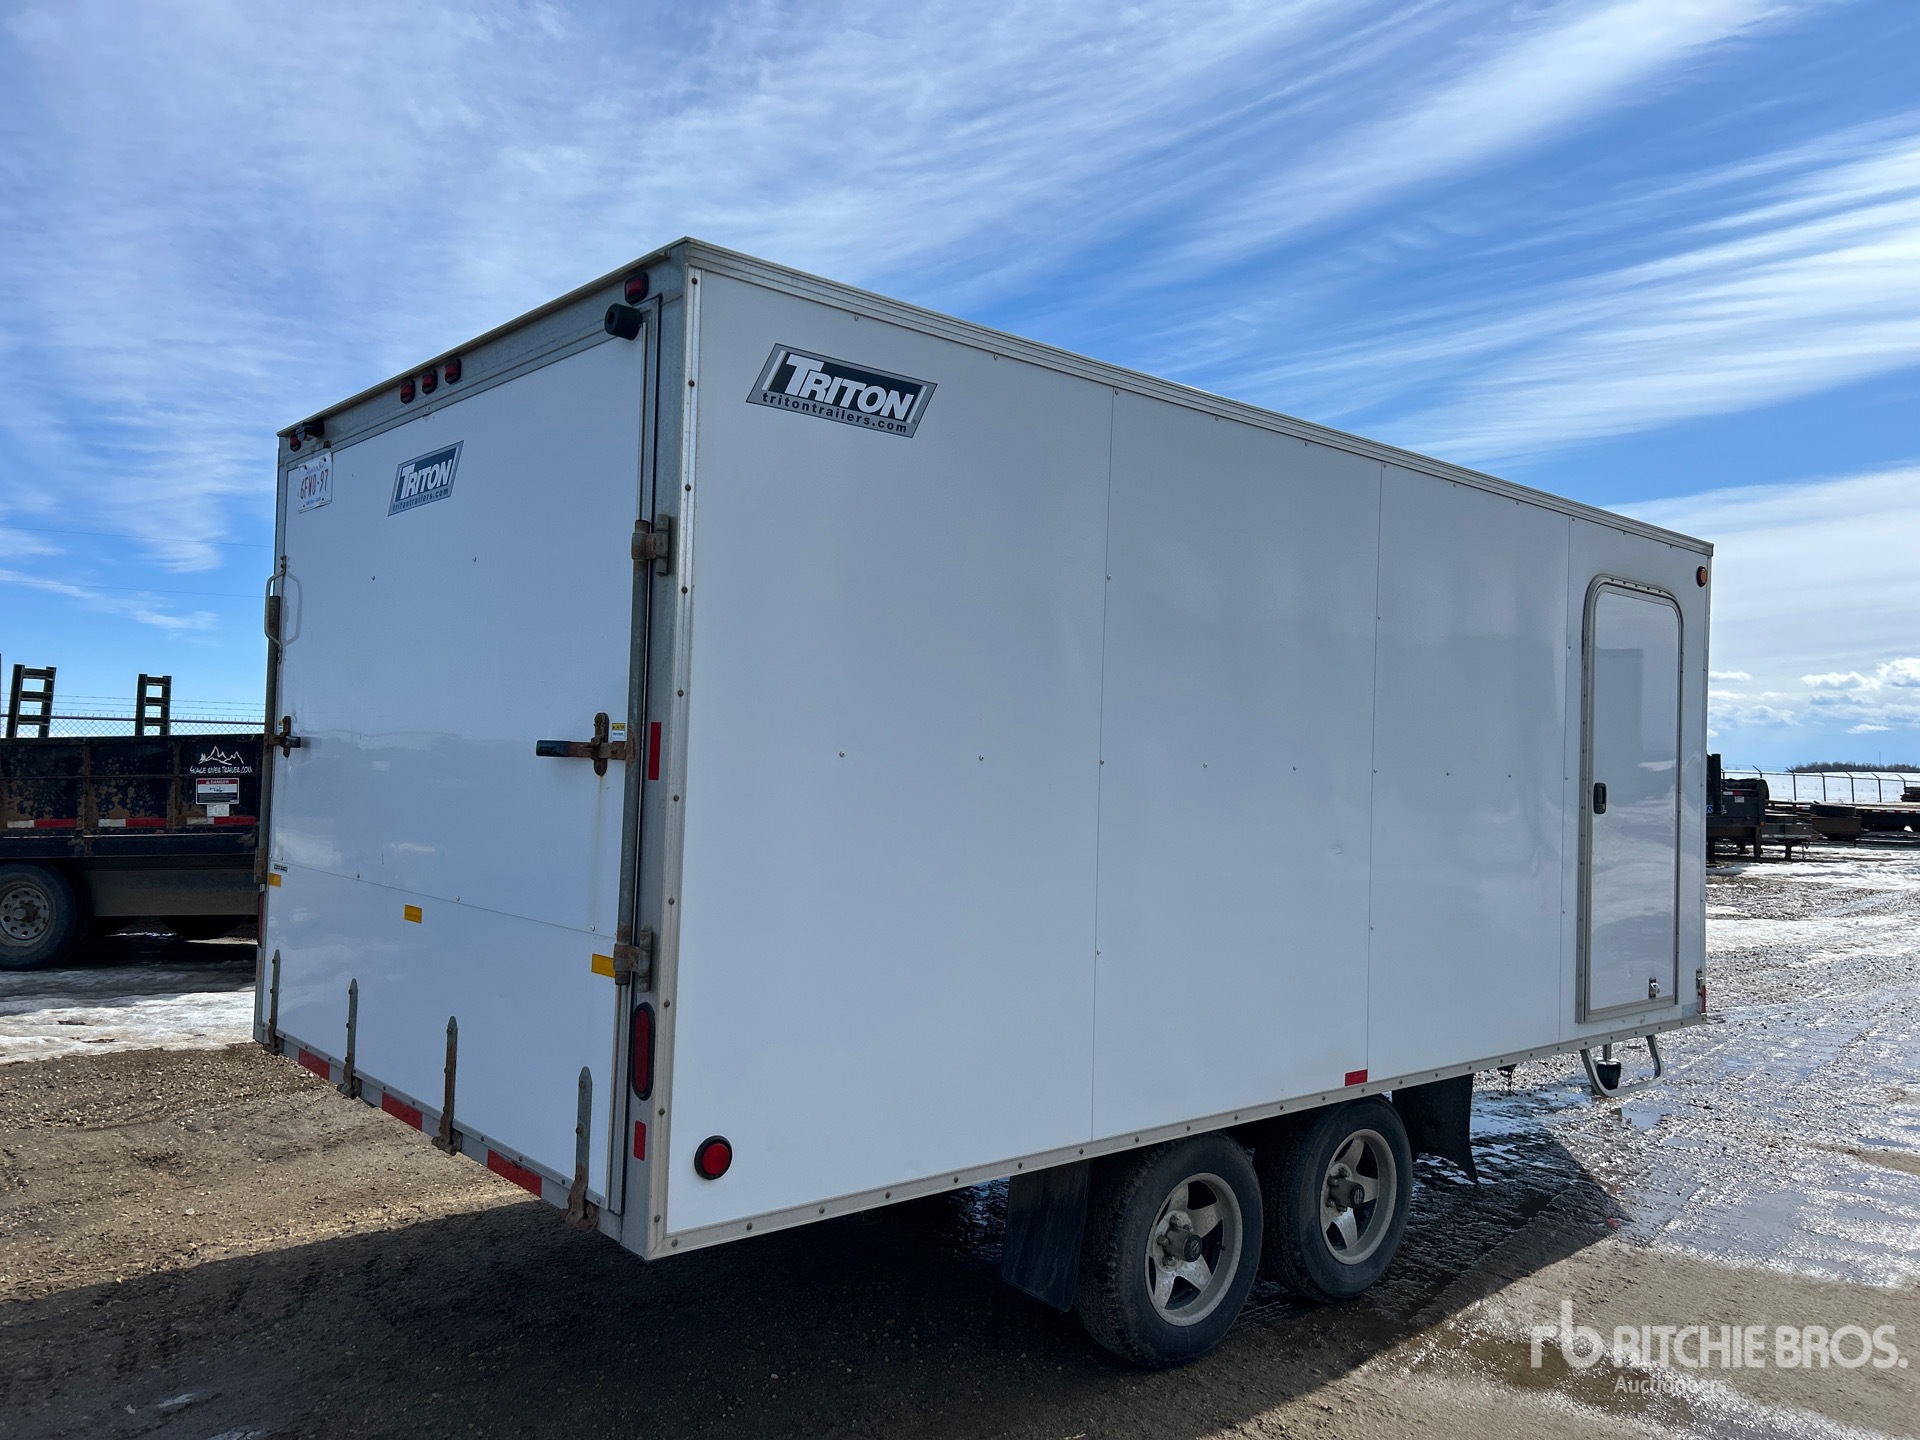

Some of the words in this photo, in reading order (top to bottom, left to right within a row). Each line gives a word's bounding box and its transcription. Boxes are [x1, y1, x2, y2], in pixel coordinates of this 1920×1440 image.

[784, 353, 914, 421] TRITON
[762, 391, 907, 433] tritontrailers.com
[392, 487, 449, 512] tritontrailers.com
[400, 458, 453, 500] TRITON
